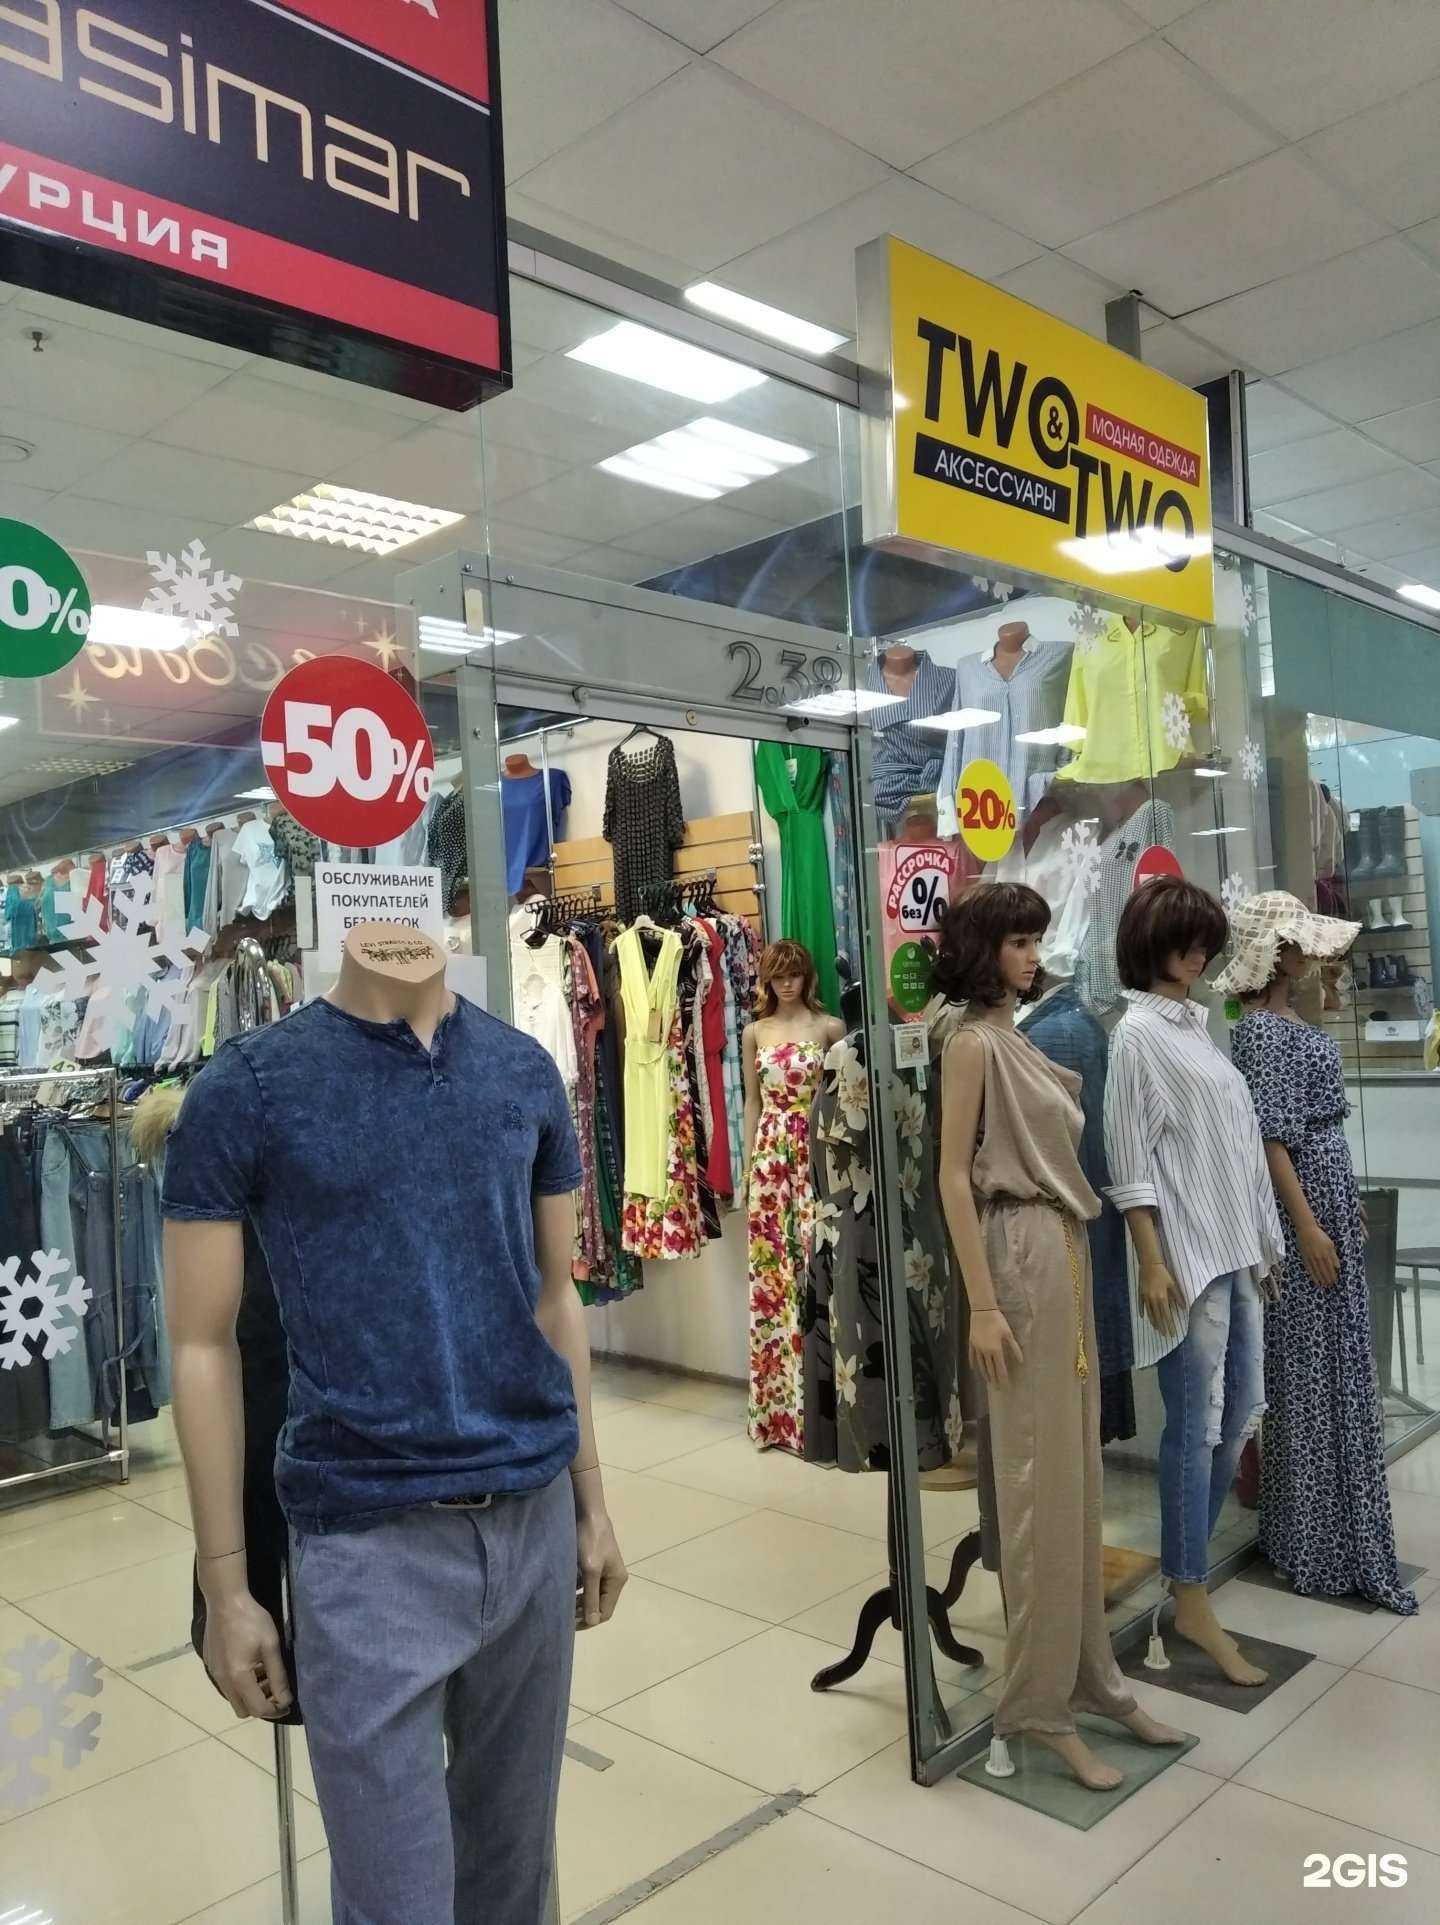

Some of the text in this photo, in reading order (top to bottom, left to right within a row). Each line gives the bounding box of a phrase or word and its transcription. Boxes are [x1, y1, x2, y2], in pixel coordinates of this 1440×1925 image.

[917, 317, 1080, 469] TWO
[1047, 405, 1063, 441] &
[1091, 413, 1197, 478] МОДНАЯ ОДЕЖДА
[934, 448, 1056, 513] АКСЕССУАРЫ
[1069, 448, 1194, 573] TWO
[261, 700, 433, 803] -50%
[957, 788, 1016, 831] -20%
[322, 872, 434, 888] ОБСЛУЖИВАНИЕ
[331, 894, 429, 909] ПОКУПАТЕЛЕЙ
[888, 852, 950, 909] РАССРОЧКА
[901, 904, 922, 919] без
